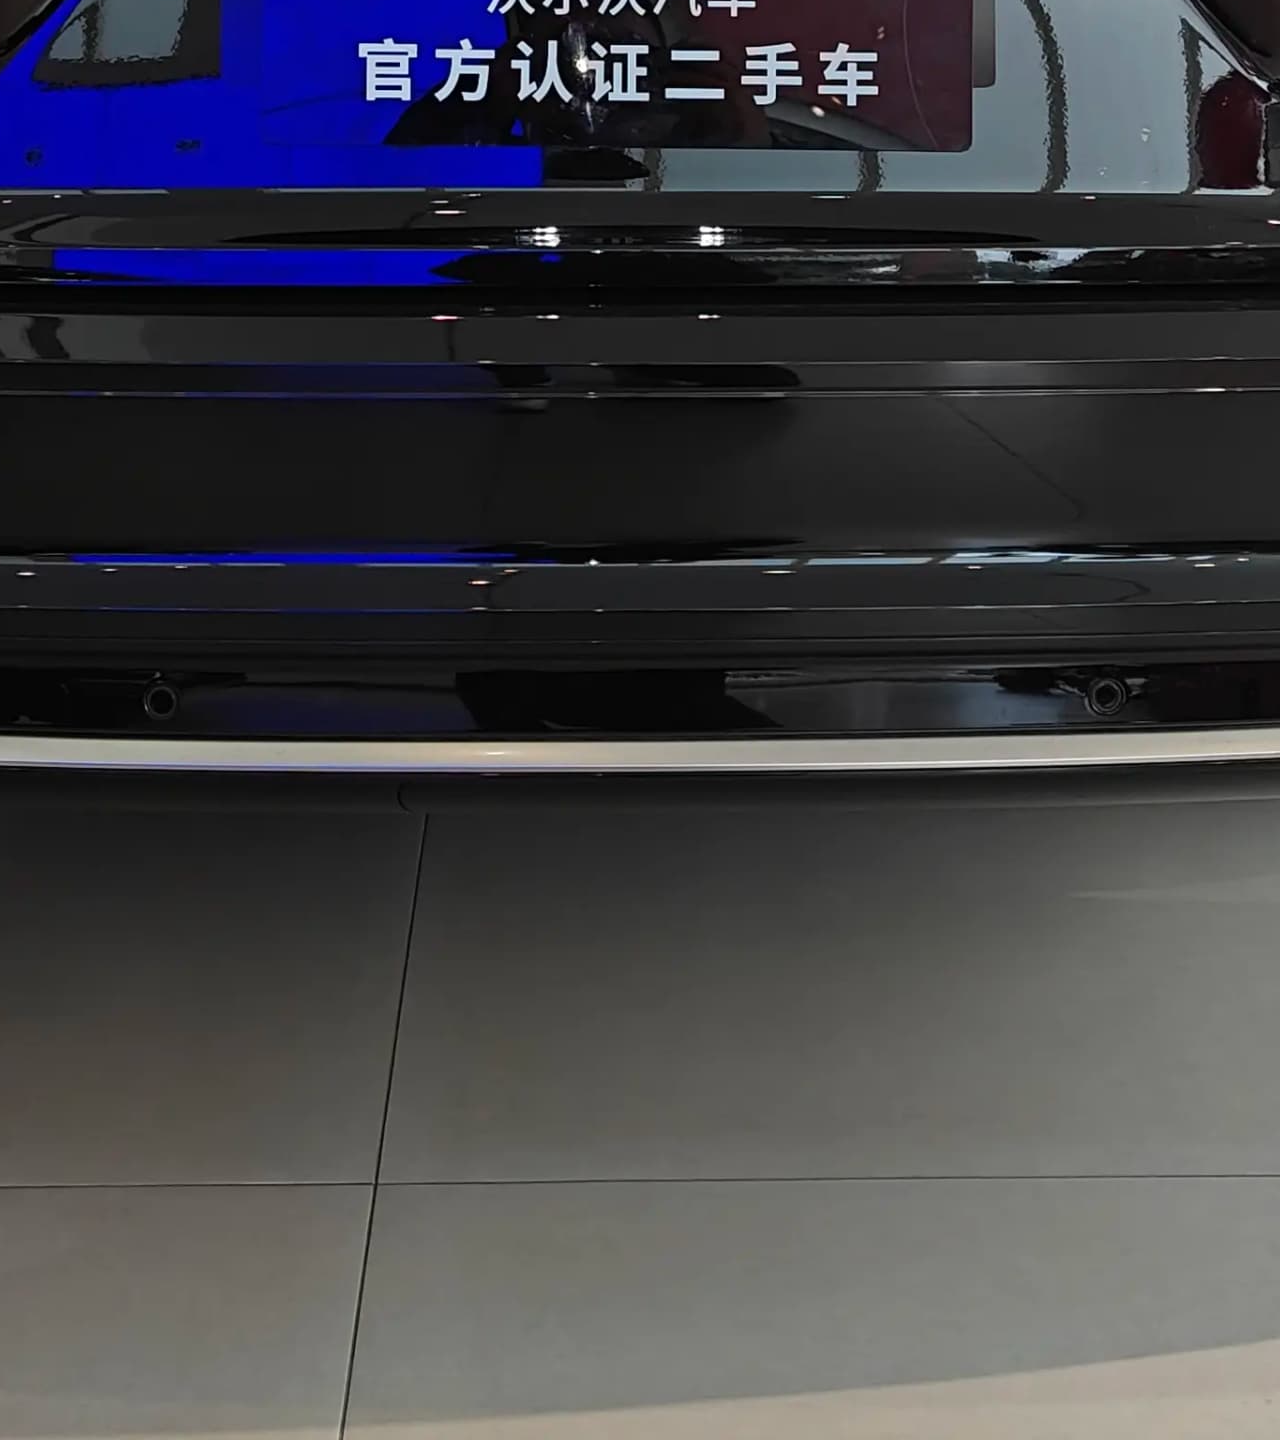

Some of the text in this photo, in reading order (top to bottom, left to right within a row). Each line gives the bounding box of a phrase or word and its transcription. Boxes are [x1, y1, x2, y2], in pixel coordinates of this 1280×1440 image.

[358, 38, 880, 106] 官方认证二手车
